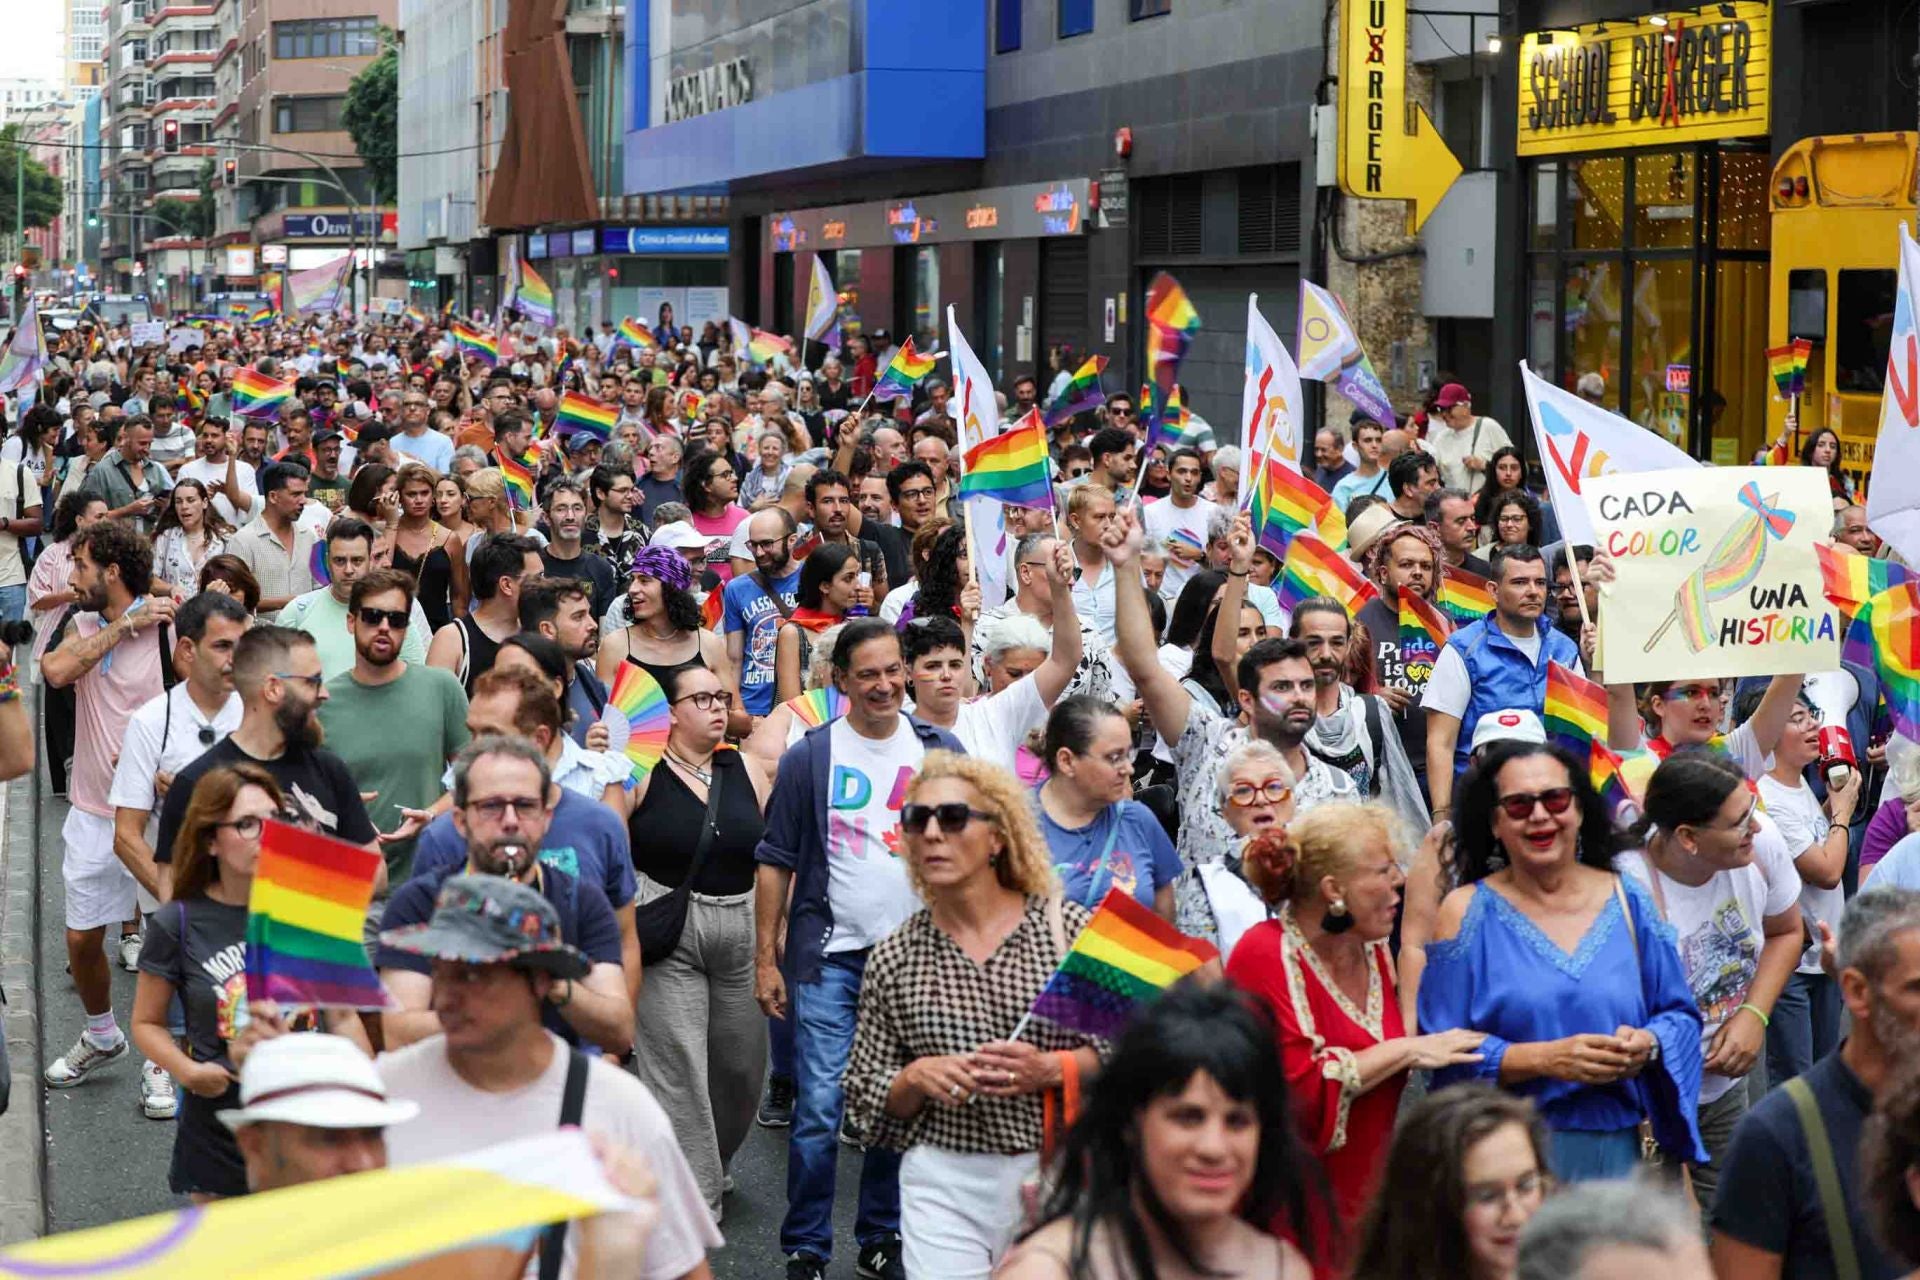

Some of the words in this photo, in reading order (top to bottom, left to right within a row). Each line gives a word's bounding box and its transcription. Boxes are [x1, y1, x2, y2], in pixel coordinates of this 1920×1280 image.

[1528, 40, 1616, 129] SCHOOL
[1600, 491, 1694, 521] CADA
[1608, 528, 1700, 557] COLOR
[1750, 583, 1808, 610] UNA
[1719, 613, 1835, 647] HISTORIA
[1378, 637, 1436, 660] Pride
[1384, 659, 1405, 676] is
